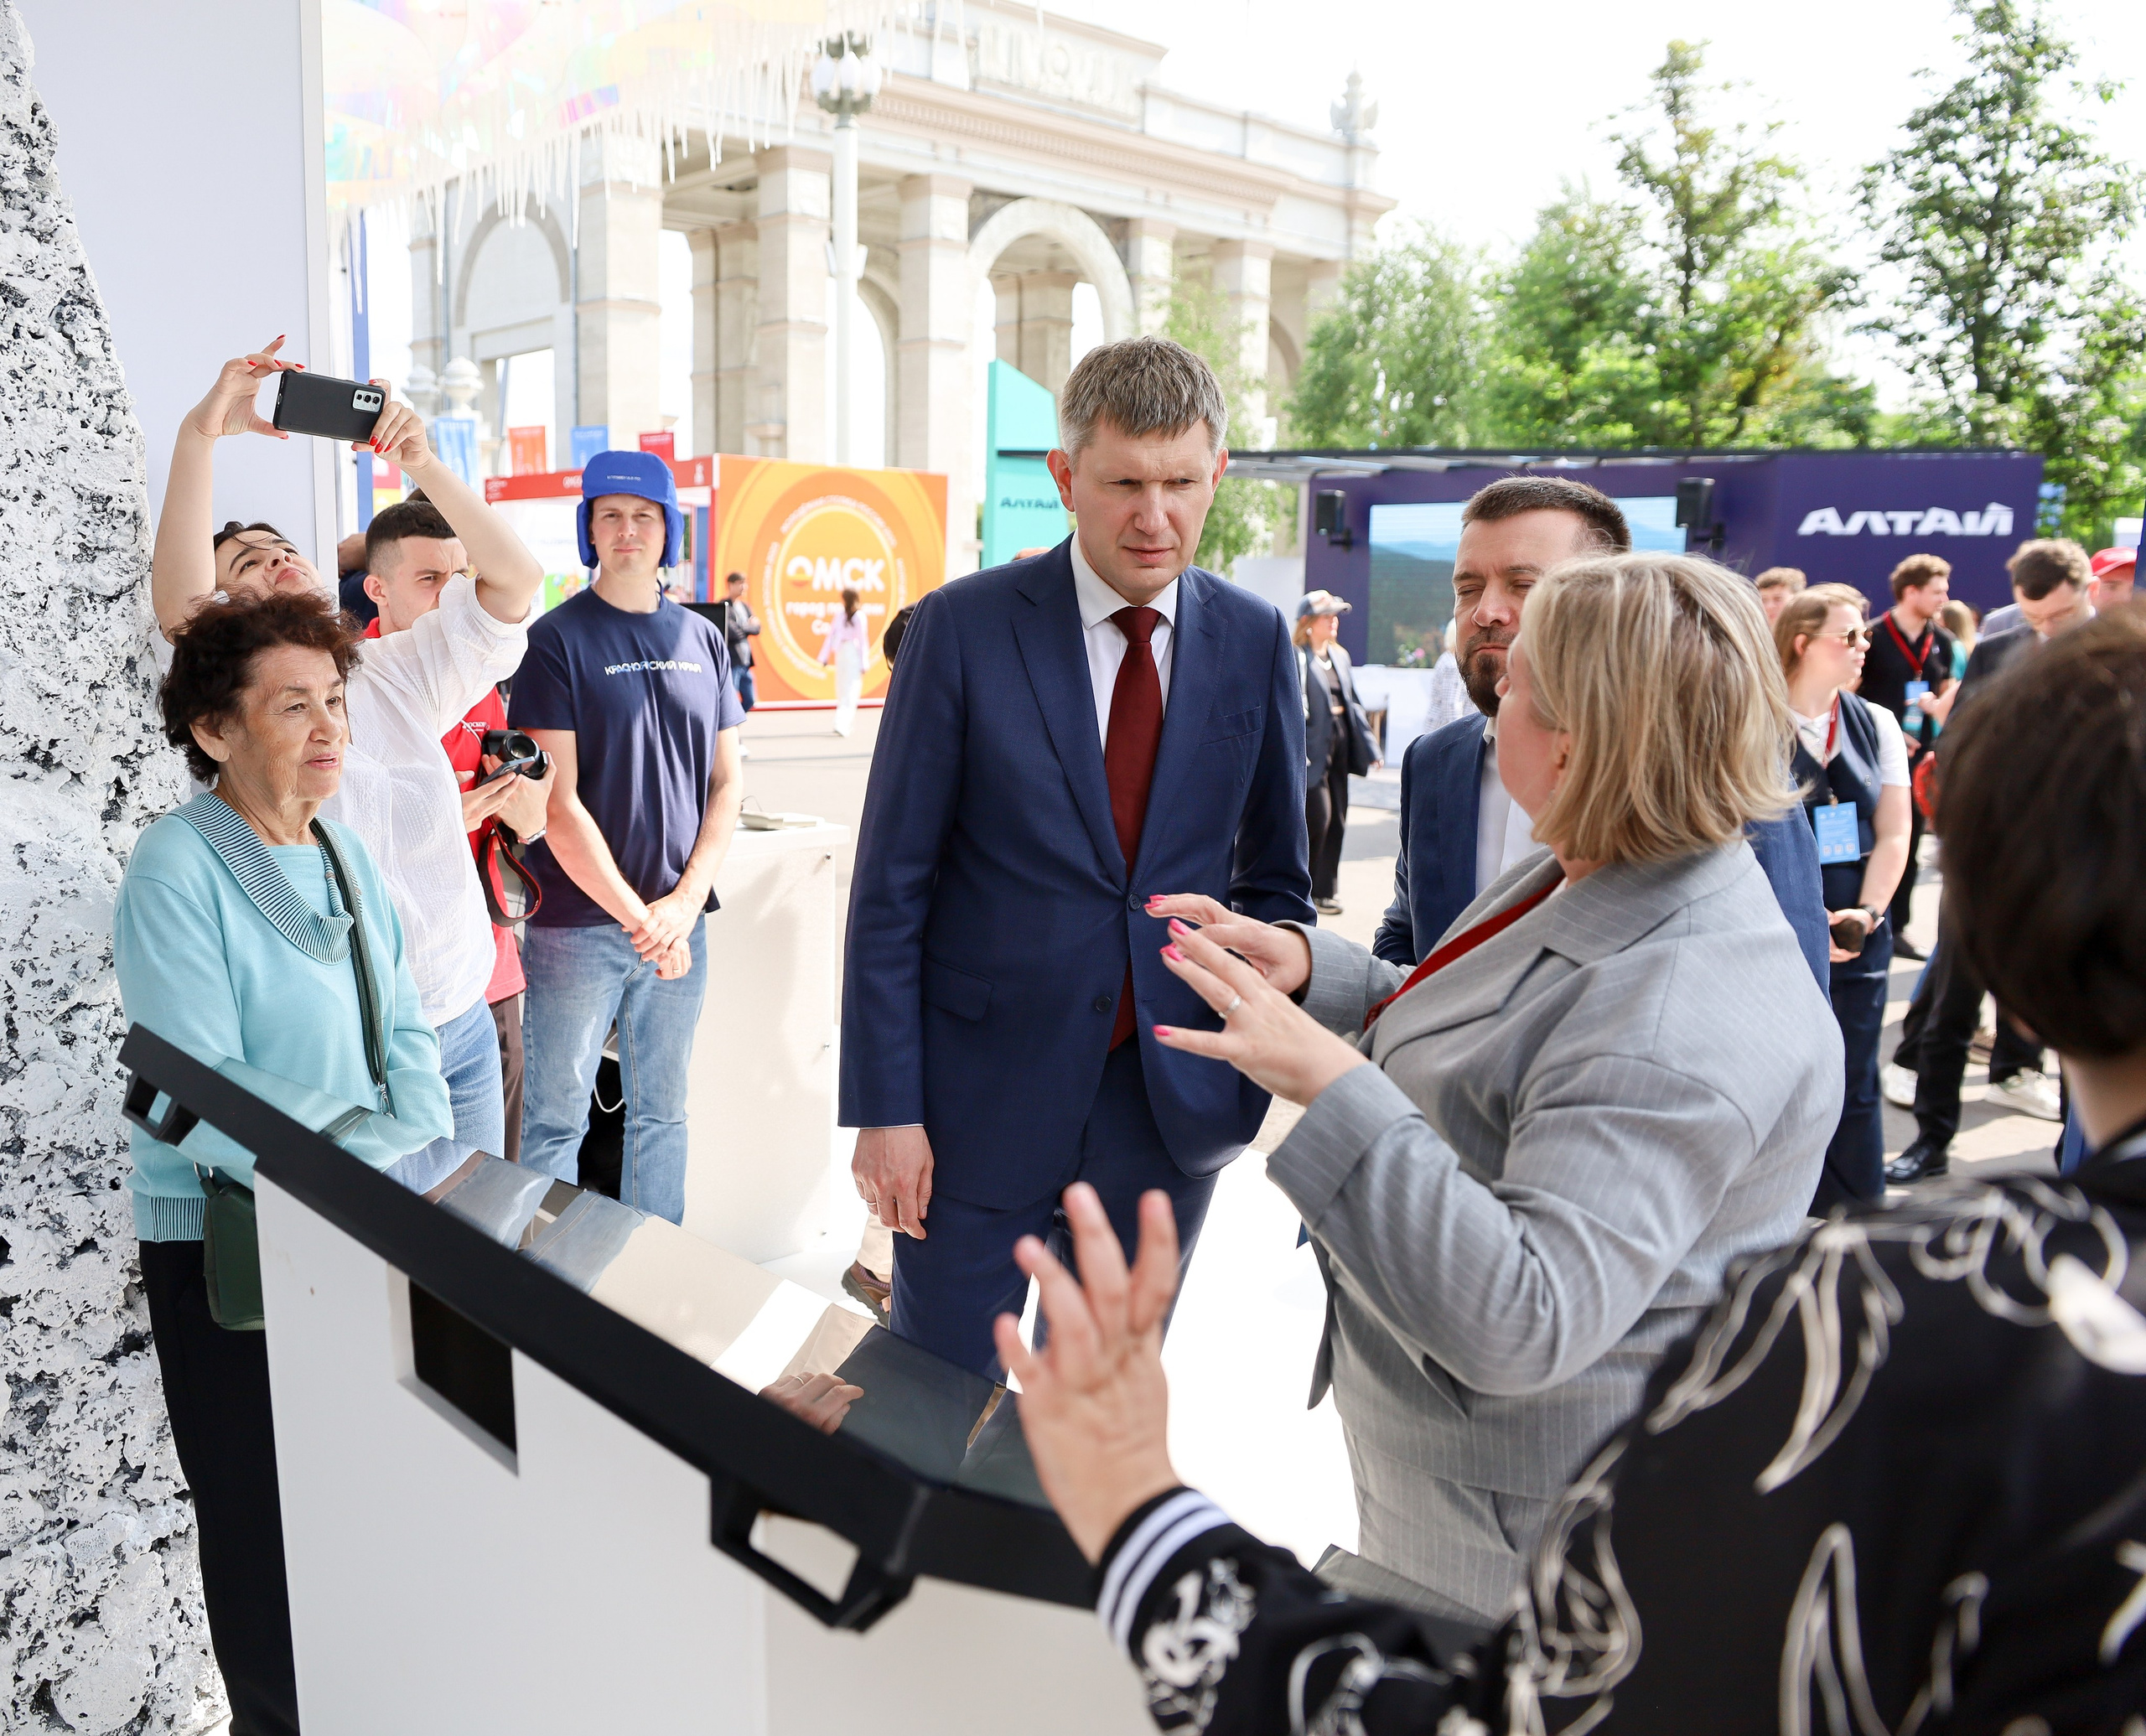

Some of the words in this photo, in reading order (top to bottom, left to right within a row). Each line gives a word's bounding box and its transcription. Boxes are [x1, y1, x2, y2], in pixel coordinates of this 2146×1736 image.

[1797, 501, 2014, 536] АЛТАЙ
[786, 556, 885, 592] ОМСК
[604, 661, 677, 676] КРАСНОЯСКИЙ
[677, 661, 702, 674] КРАЙ
